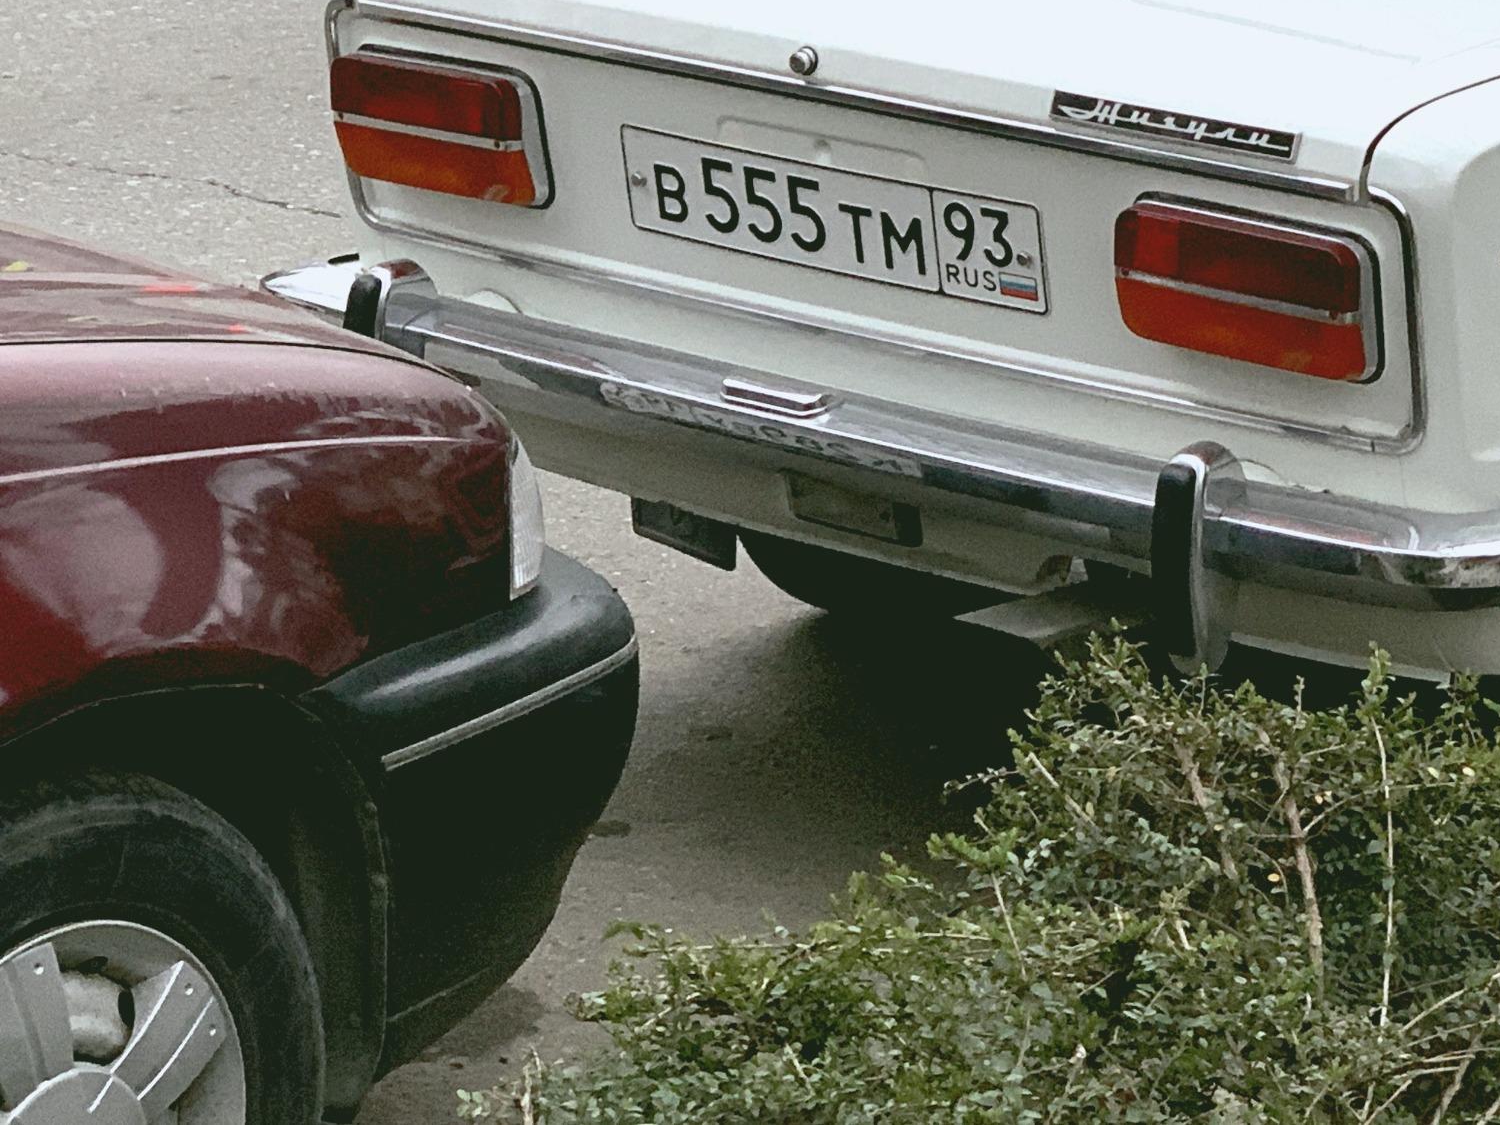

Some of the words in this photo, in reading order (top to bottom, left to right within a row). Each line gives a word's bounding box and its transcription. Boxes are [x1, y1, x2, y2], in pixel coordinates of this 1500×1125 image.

[1057, 99, 1289, 150] Жигули
[943, 201, 1014, 268] 93
[945, 264, 997, 292] RUS
